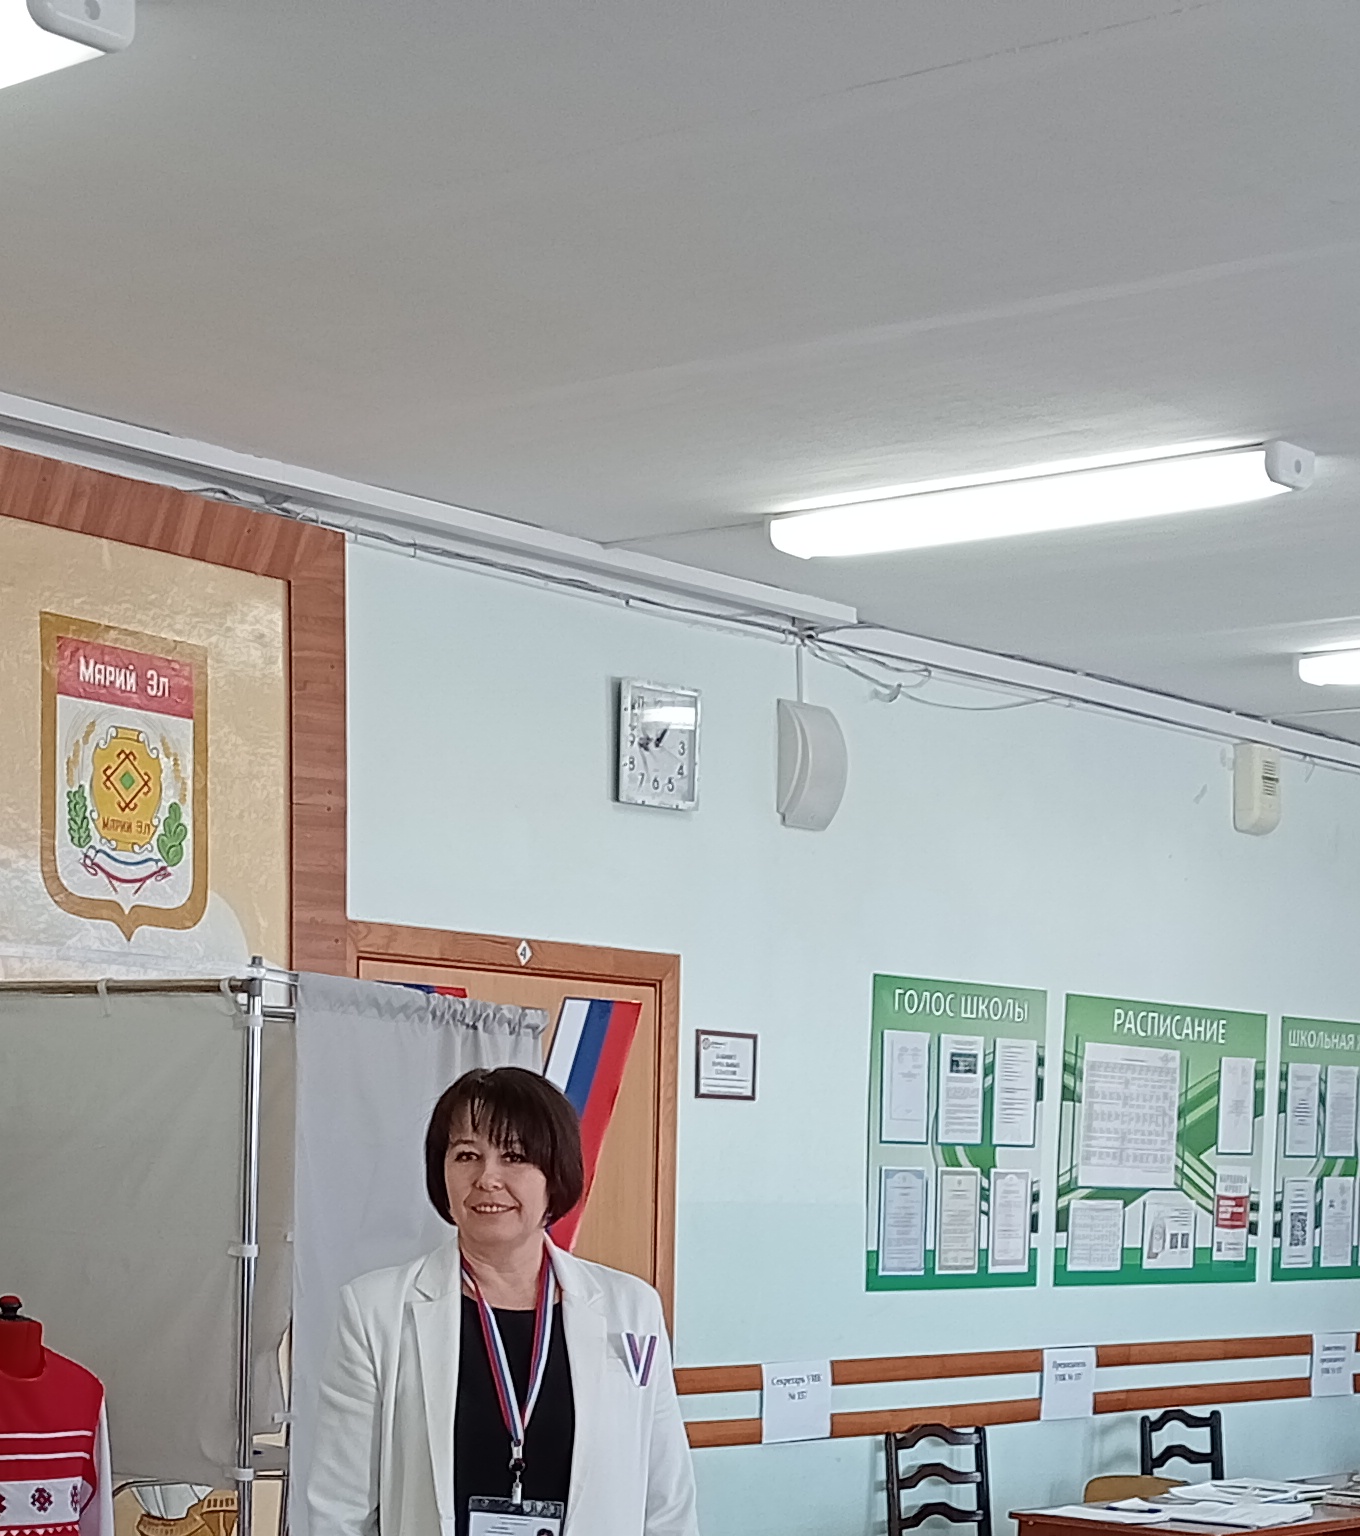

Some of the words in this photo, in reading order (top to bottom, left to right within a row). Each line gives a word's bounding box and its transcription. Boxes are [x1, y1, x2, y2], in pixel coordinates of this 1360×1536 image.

[678, 740, 686, 756] 3
[652, 777, 660, 791] 6
[667, 777, 675, 792] 5
[894, 988, 956, 1017] ГОЛОС
[960, 994, 1029, 1022] ШКОЛЫ
[1113, 1008, 1227, 1044] РАСПИСАНИЕ
[1288, 1029, 1355, 1051] ШКОЛЬНАЯ
